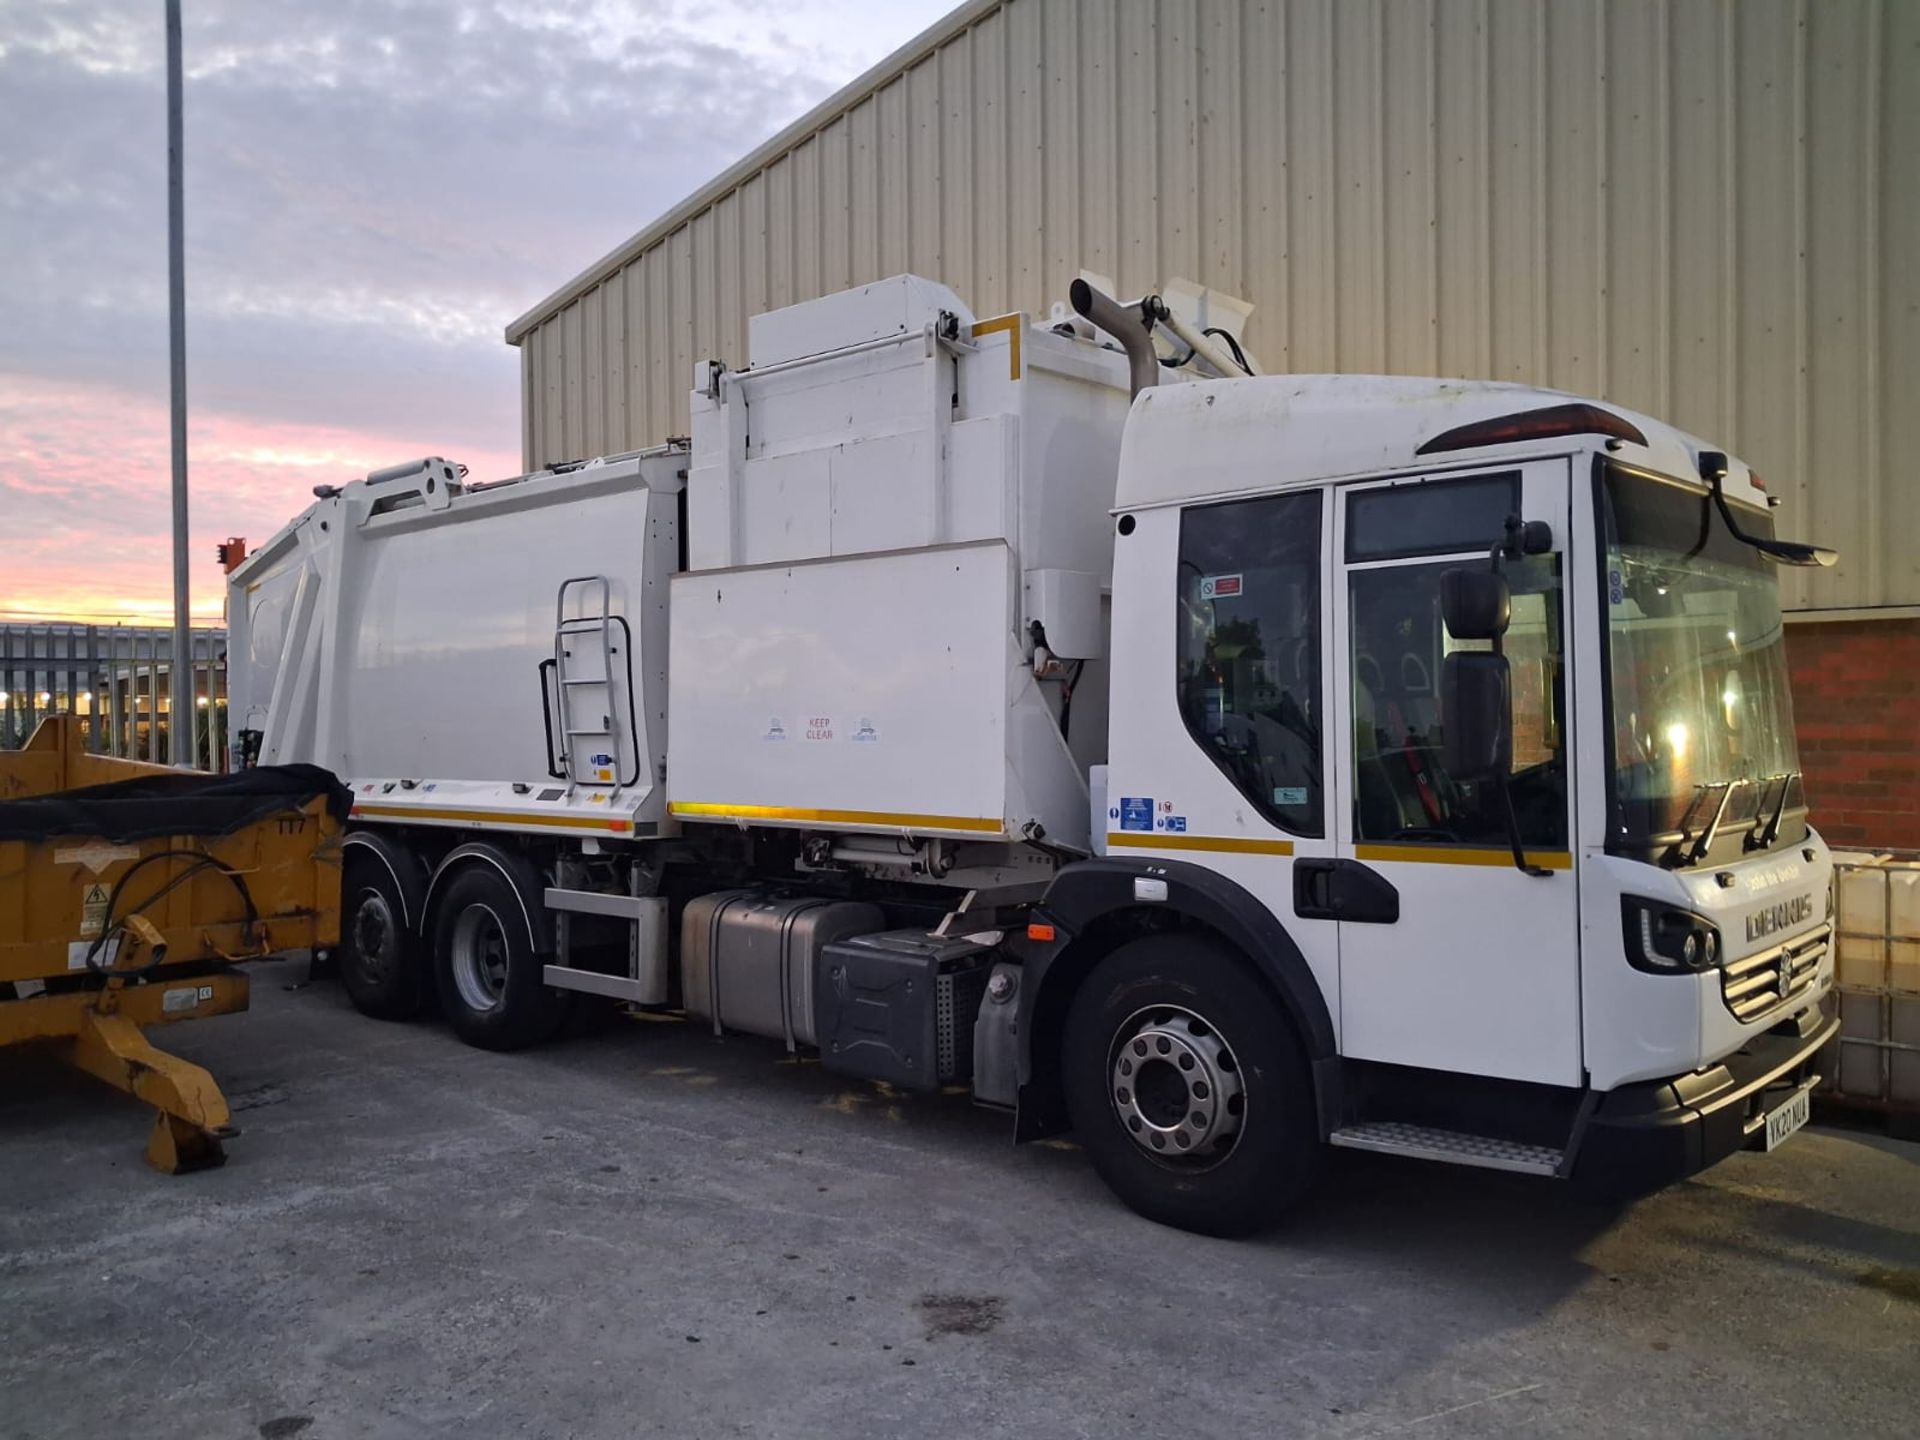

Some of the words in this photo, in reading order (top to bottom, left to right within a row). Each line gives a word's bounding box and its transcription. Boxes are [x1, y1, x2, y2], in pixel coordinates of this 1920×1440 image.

[809, 718, 830, 728] KEEP
[806, 730, 832, 740] CLEAR
[1746, 892, 1812, 943] DENNIS
